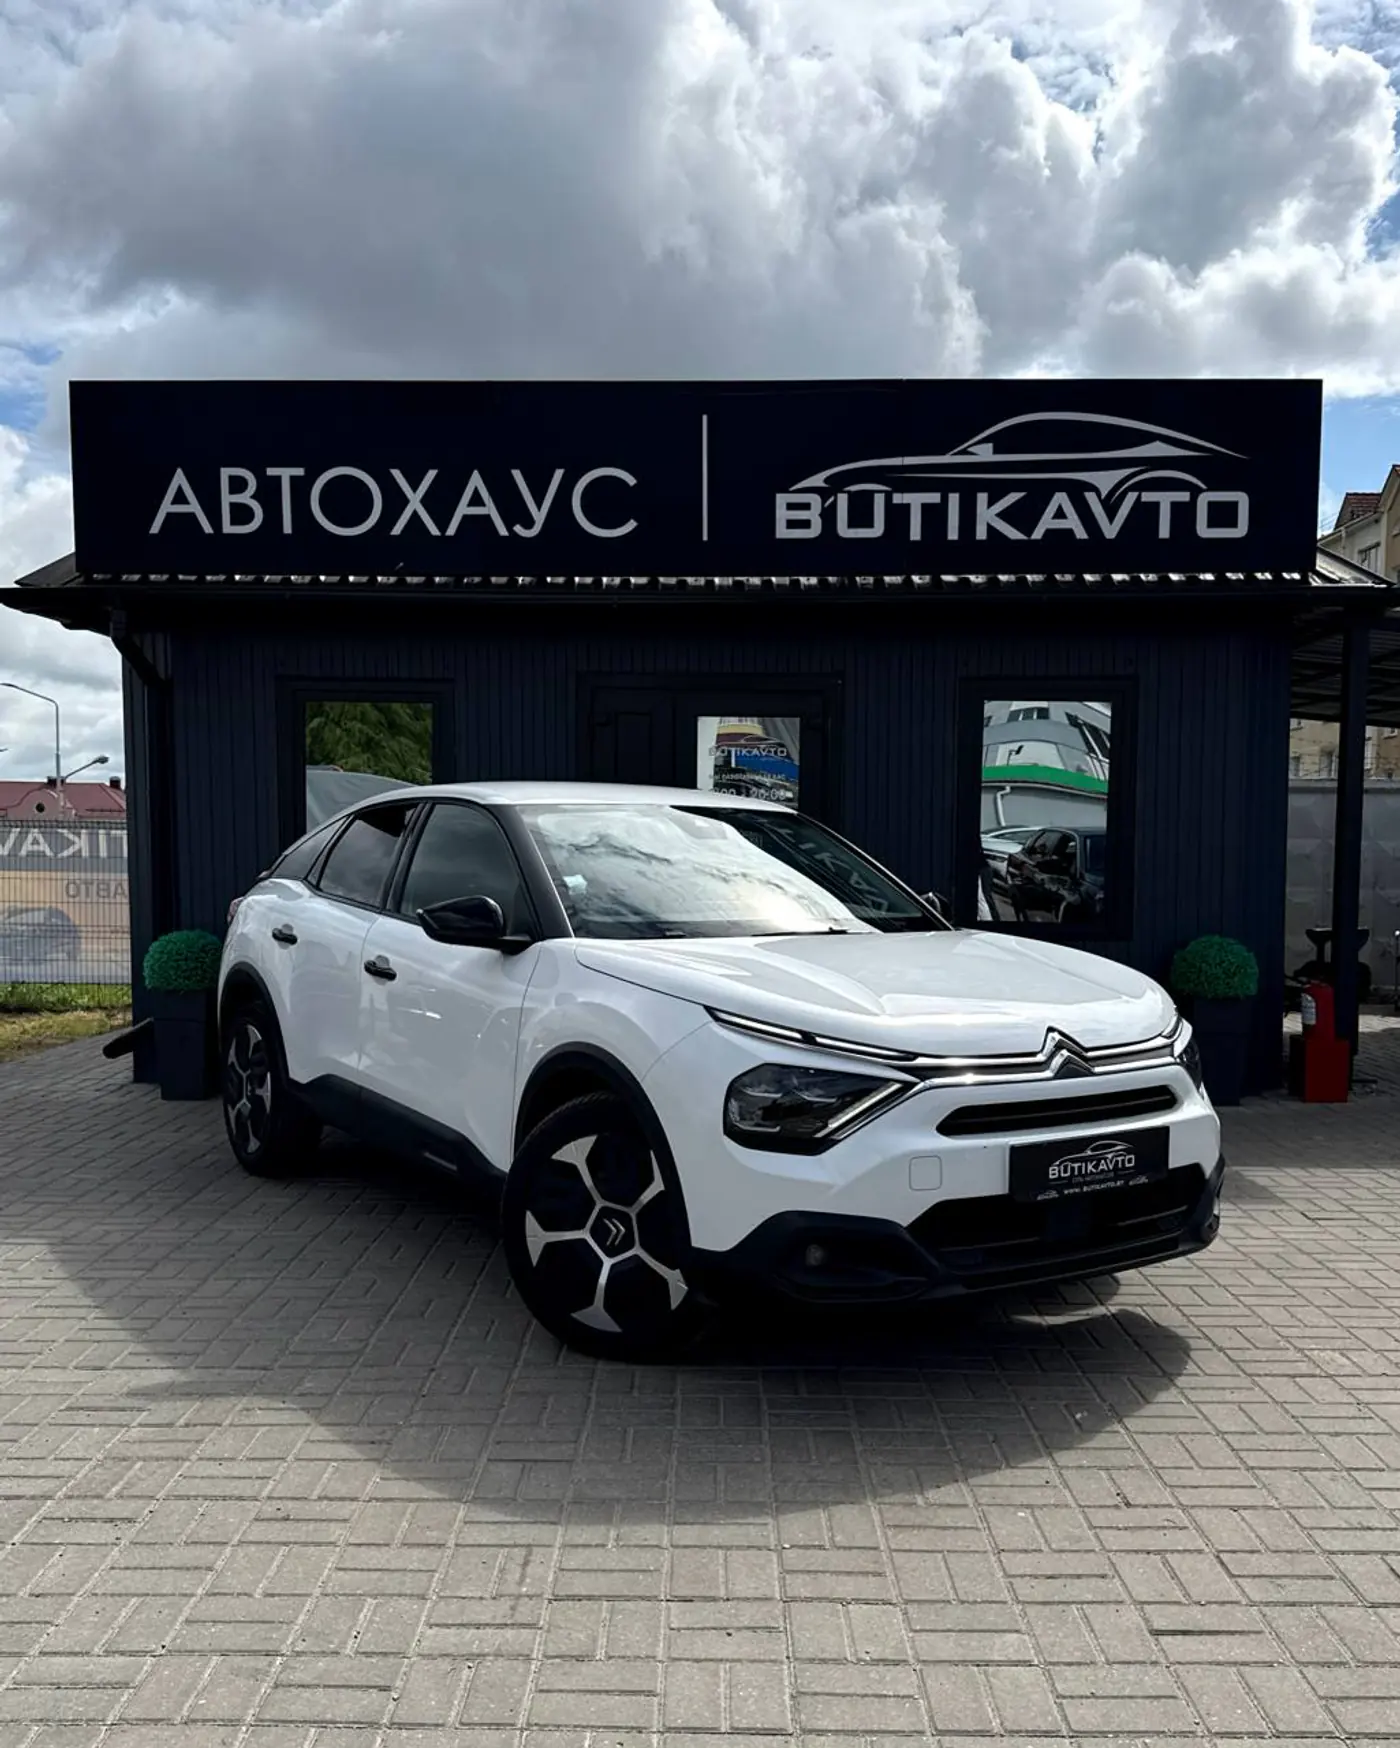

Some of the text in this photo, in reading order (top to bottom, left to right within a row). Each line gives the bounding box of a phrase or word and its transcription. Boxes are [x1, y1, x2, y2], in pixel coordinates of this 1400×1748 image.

[149, 466, 638, 538] АВТОХАУС
[775, 491, 1250, 541] BUTIKAVTO
[708, 746, 788, 758] BUTIKAVTO
[1048, 1154, 1136, 1179] BUTIKAVTO
